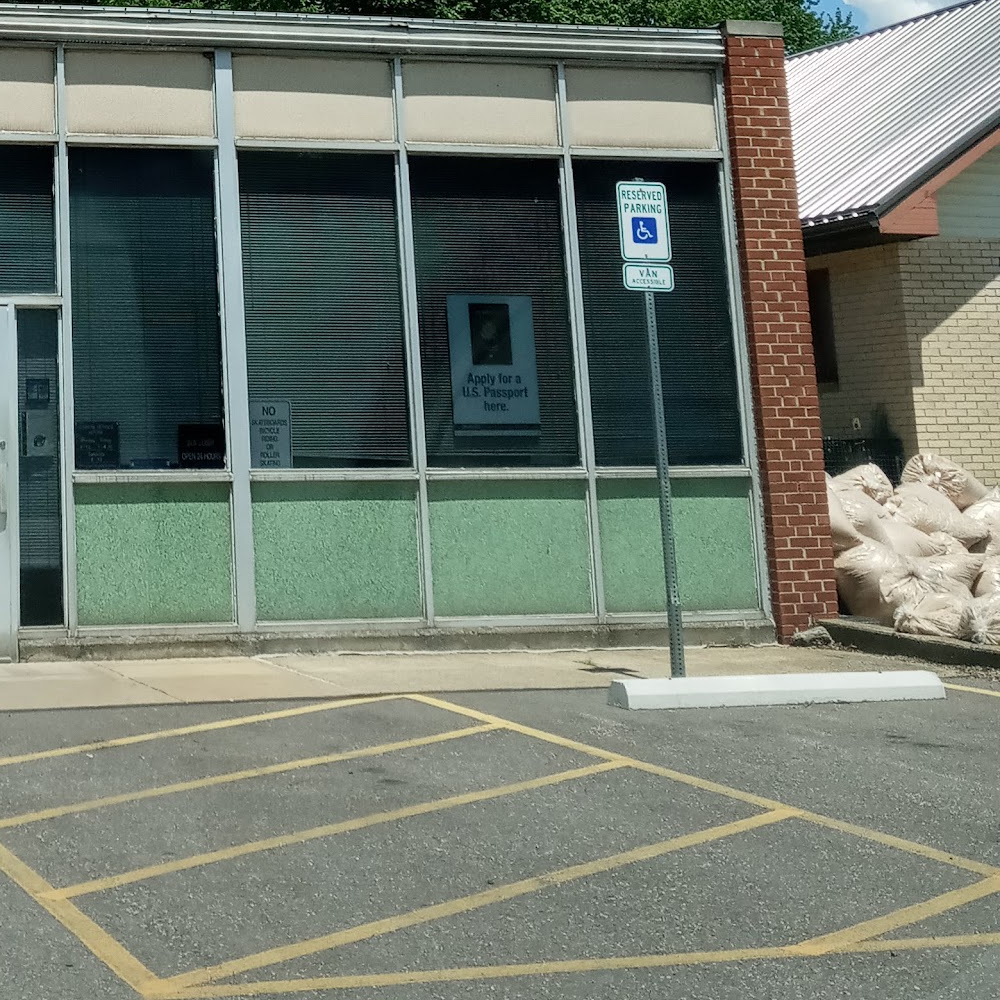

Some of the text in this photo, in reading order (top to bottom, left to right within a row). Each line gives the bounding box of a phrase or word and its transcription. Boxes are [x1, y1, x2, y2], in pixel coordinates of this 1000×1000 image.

[621, 190, 662, 201] RESERVED
[624, 203, 662, 214] PARKING
[639, 269, 658, 278] VAN
[632, 278, 666, 286] ACCESSIBLE
[467, 372, 522, 386] Apply for a
[462, 386, 529, 400] U.S. Passport
[262, 406, 276, 416] NO
[483, 400, 509, 412] here.
